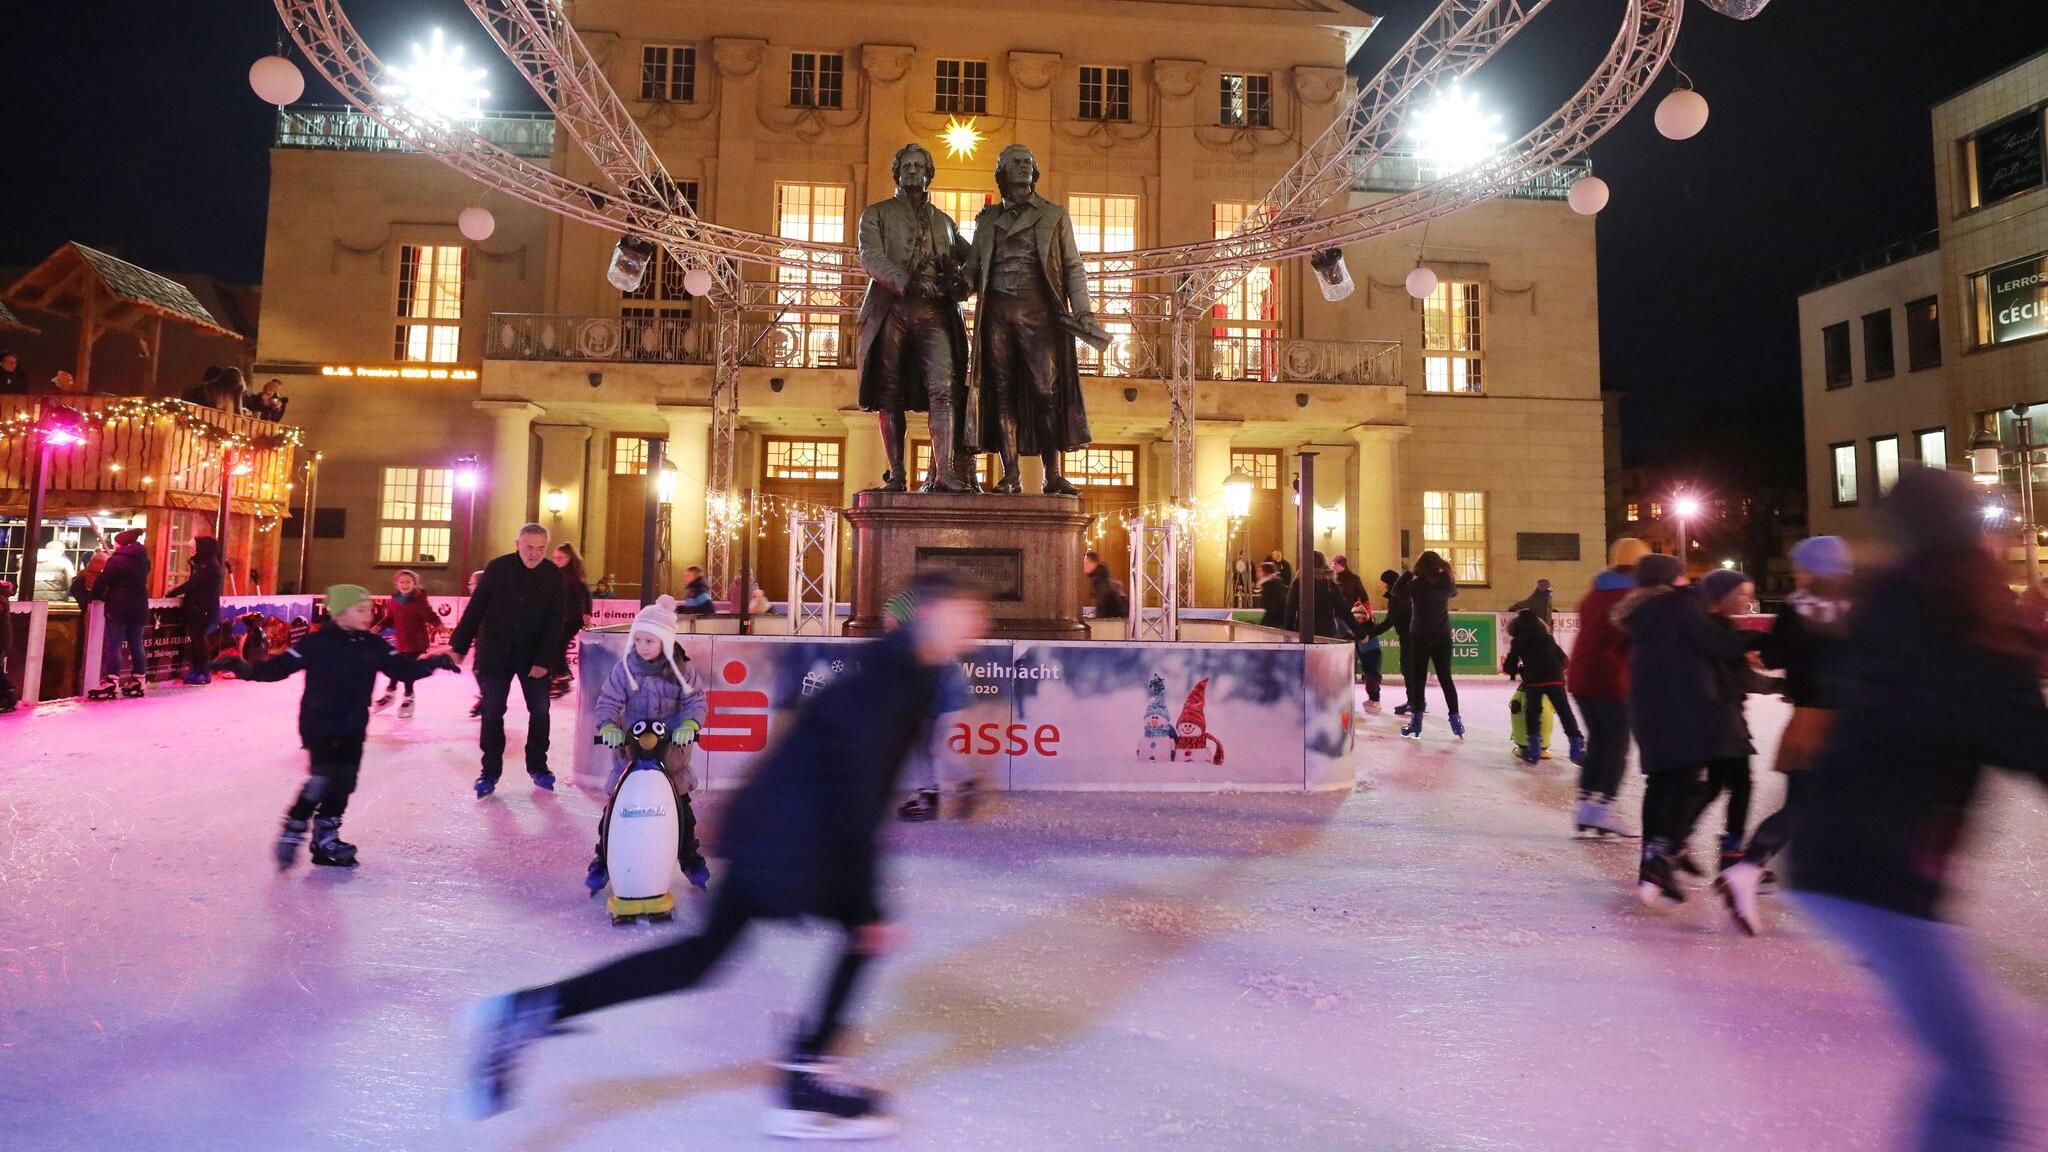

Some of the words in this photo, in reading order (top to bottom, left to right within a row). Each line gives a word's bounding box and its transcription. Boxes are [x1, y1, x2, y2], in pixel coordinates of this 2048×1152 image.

[1997, 273, 2047, 293] LERROS
[604, 610, 635, 619] einen
[1452, 648, 1479, 657] LUS
[961, 662, 1060, 679] Weihnacht
[969, 685, 999, 694] 2020
[947, 723, 1060, 756] asse
